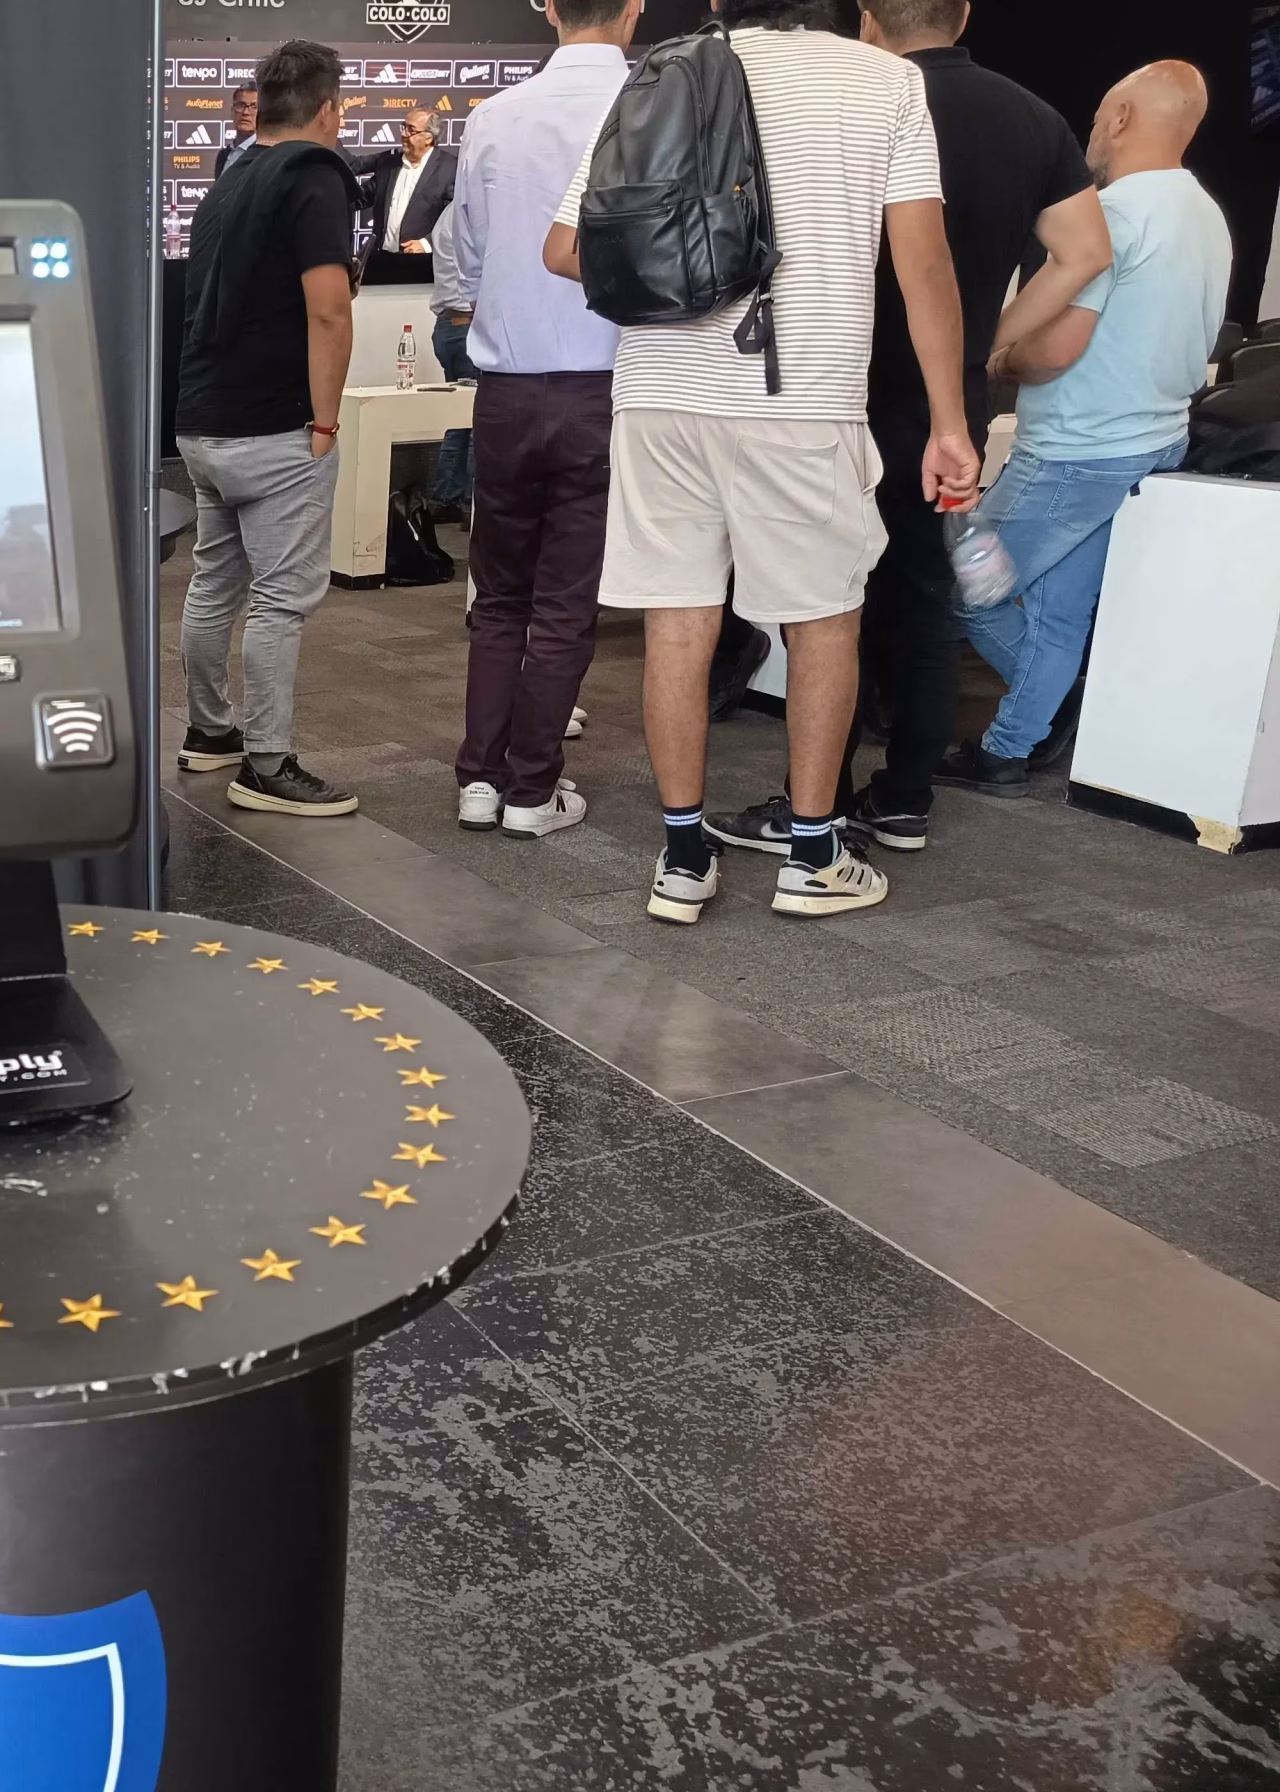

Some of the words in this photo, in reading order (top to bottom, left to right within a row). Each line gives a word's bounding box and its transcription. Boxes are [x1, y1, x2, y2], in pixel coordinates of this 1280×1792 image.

[227, 68, 255, 79] DIREC
[503, 66, 533, 75] PHILIPS
[383, 98, 417, 108] DIRECTV
[173, 155, 201, 163] PHILIPS
